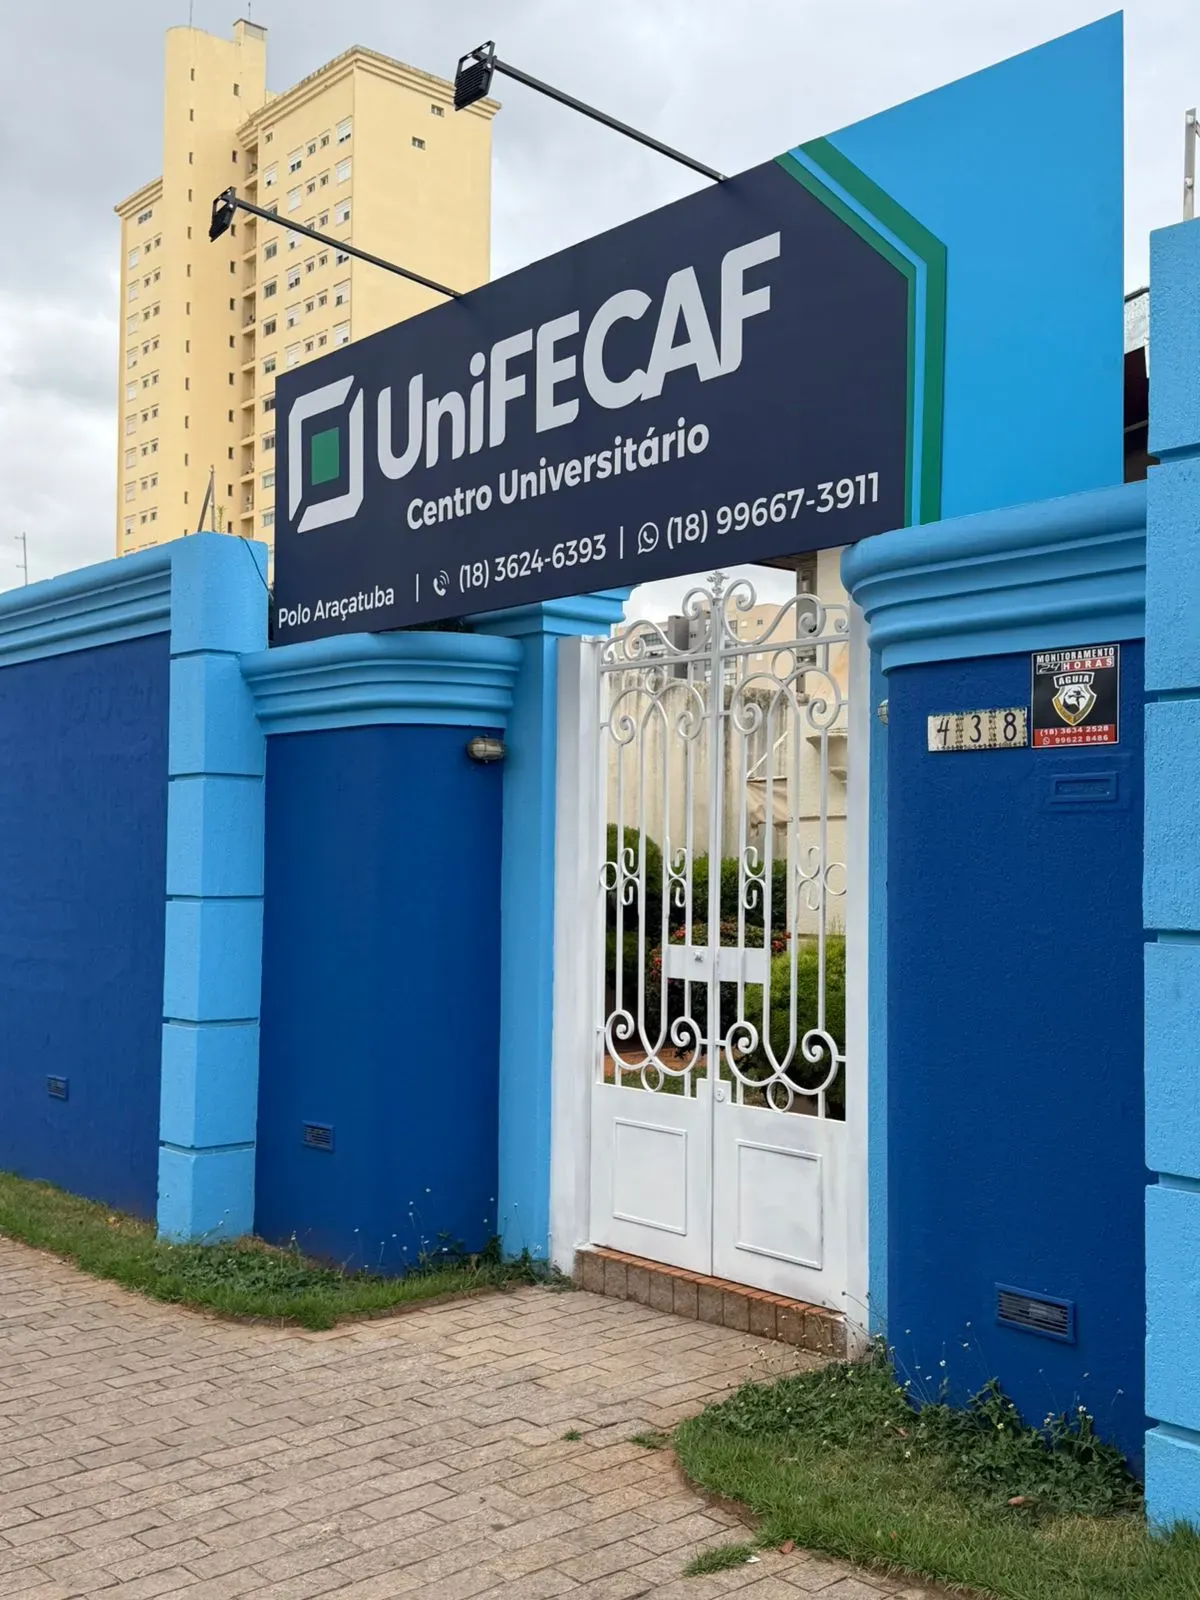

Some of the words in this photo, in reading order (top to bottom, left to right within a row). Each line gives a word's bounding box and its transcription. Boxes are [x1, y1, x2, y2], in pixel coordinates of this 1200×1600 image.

[376, 231, 781, 480] UniFECAF
[406, 483, 493, 531] Centro
[498, 416, 710, 506] Universitário
[278, 603, 311, 629] Polo
[314, 585, 395, 622] Araçatuba
[459, 560, 490, 593] (18)
[494, 533, 607, 583] 3624-6393
[667, 510, 709, 550] (18)
[716, 471, 879, 536] 99667-3911
[1036, 647, 1115, 663] MONITORAMENTO
[1063, 657, 1113, 671] HORAS
